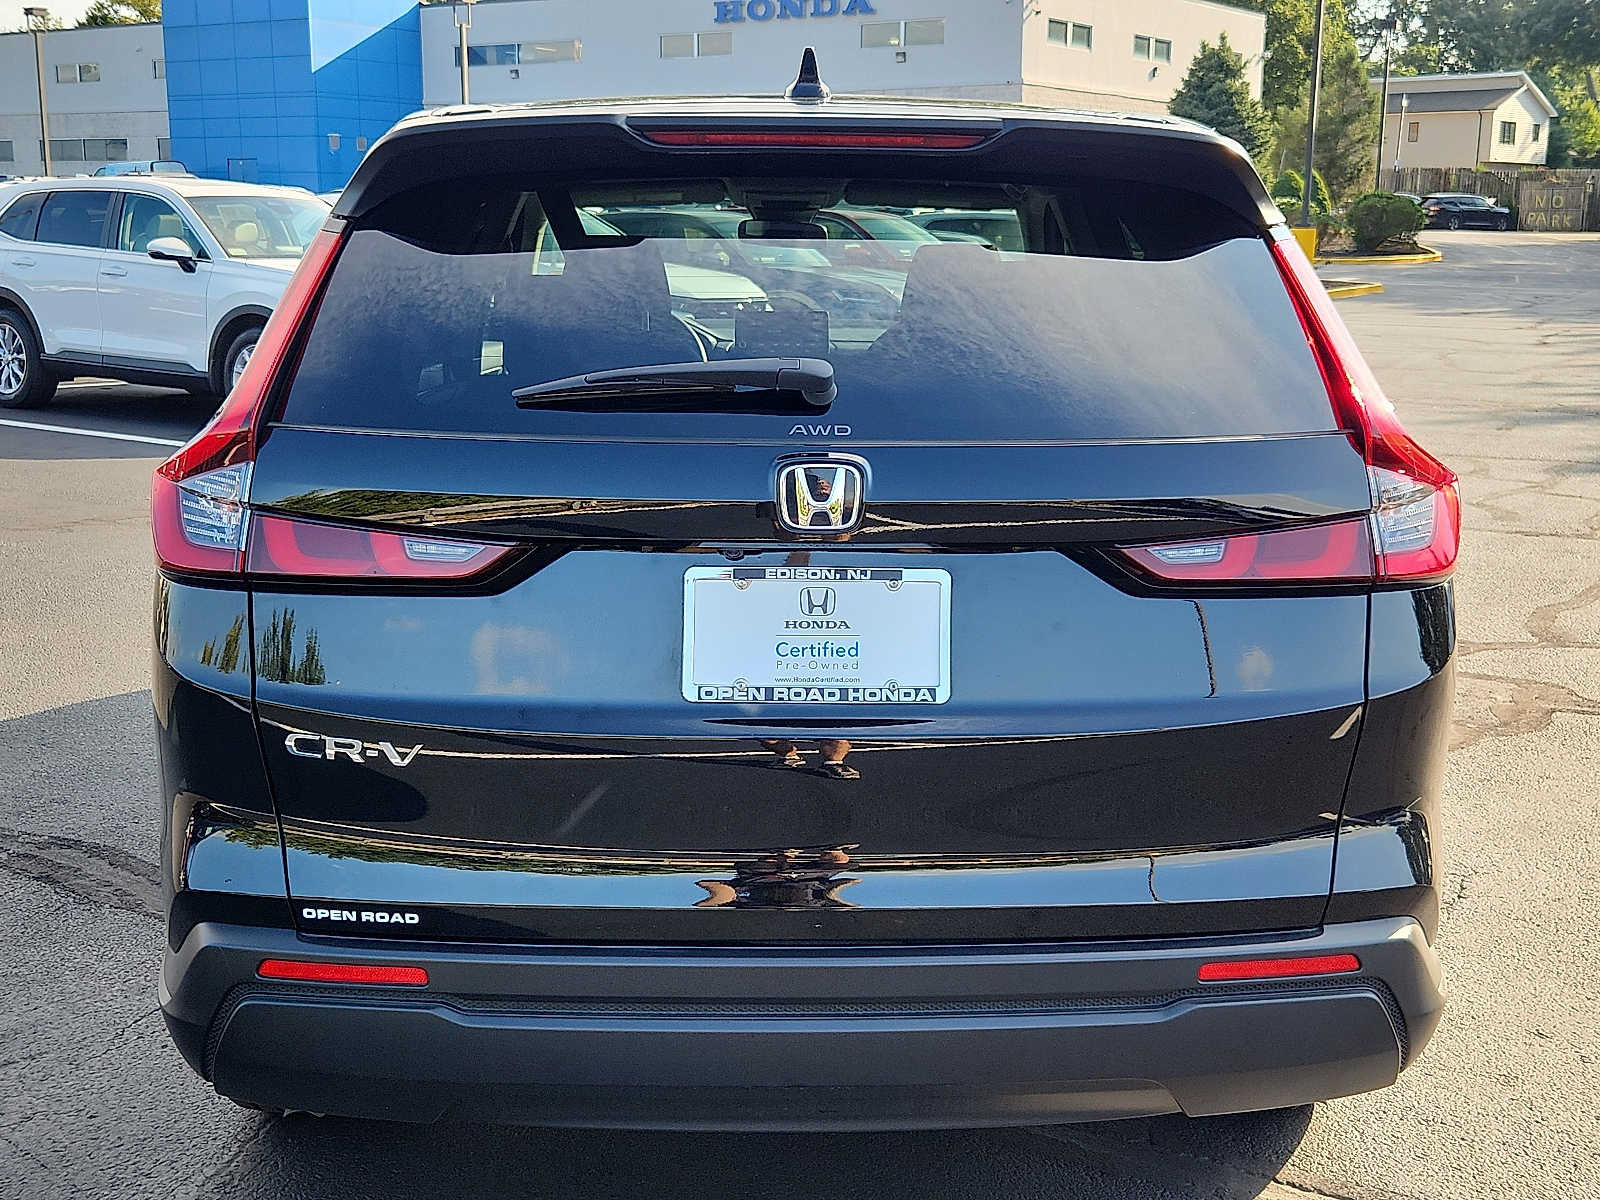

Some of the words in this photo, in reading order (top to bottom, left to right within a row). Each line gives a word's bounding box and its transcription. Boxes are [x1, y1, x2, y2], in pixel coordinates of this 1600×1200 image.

[714, 0, 876, 24] HONDA
[1535, 194, 1564, 209] NO
[1527, 211, 1571, 228] PARK
[789, 424, 852, 436] AWD
[764, 568, 841, 580] EDISON,
[847, 569, 872, 580] NJ
[784, 620, 850, 630] HONDA
[775, 641, 859, 658] Certified
[776, 660, 859, 670] Pre-Owned
[774, 676, 861, 684] www.HondaCertified.com
[700, 686, 766, 701] OPEN
[773, 687, 841, 701] ROAD
[848, 687, 934, 702] HONDA
[284, 733, 424, 767] CR-V
[302, 908, 357, 922] OPEN
[361, 911, 420, 924] ROAD
